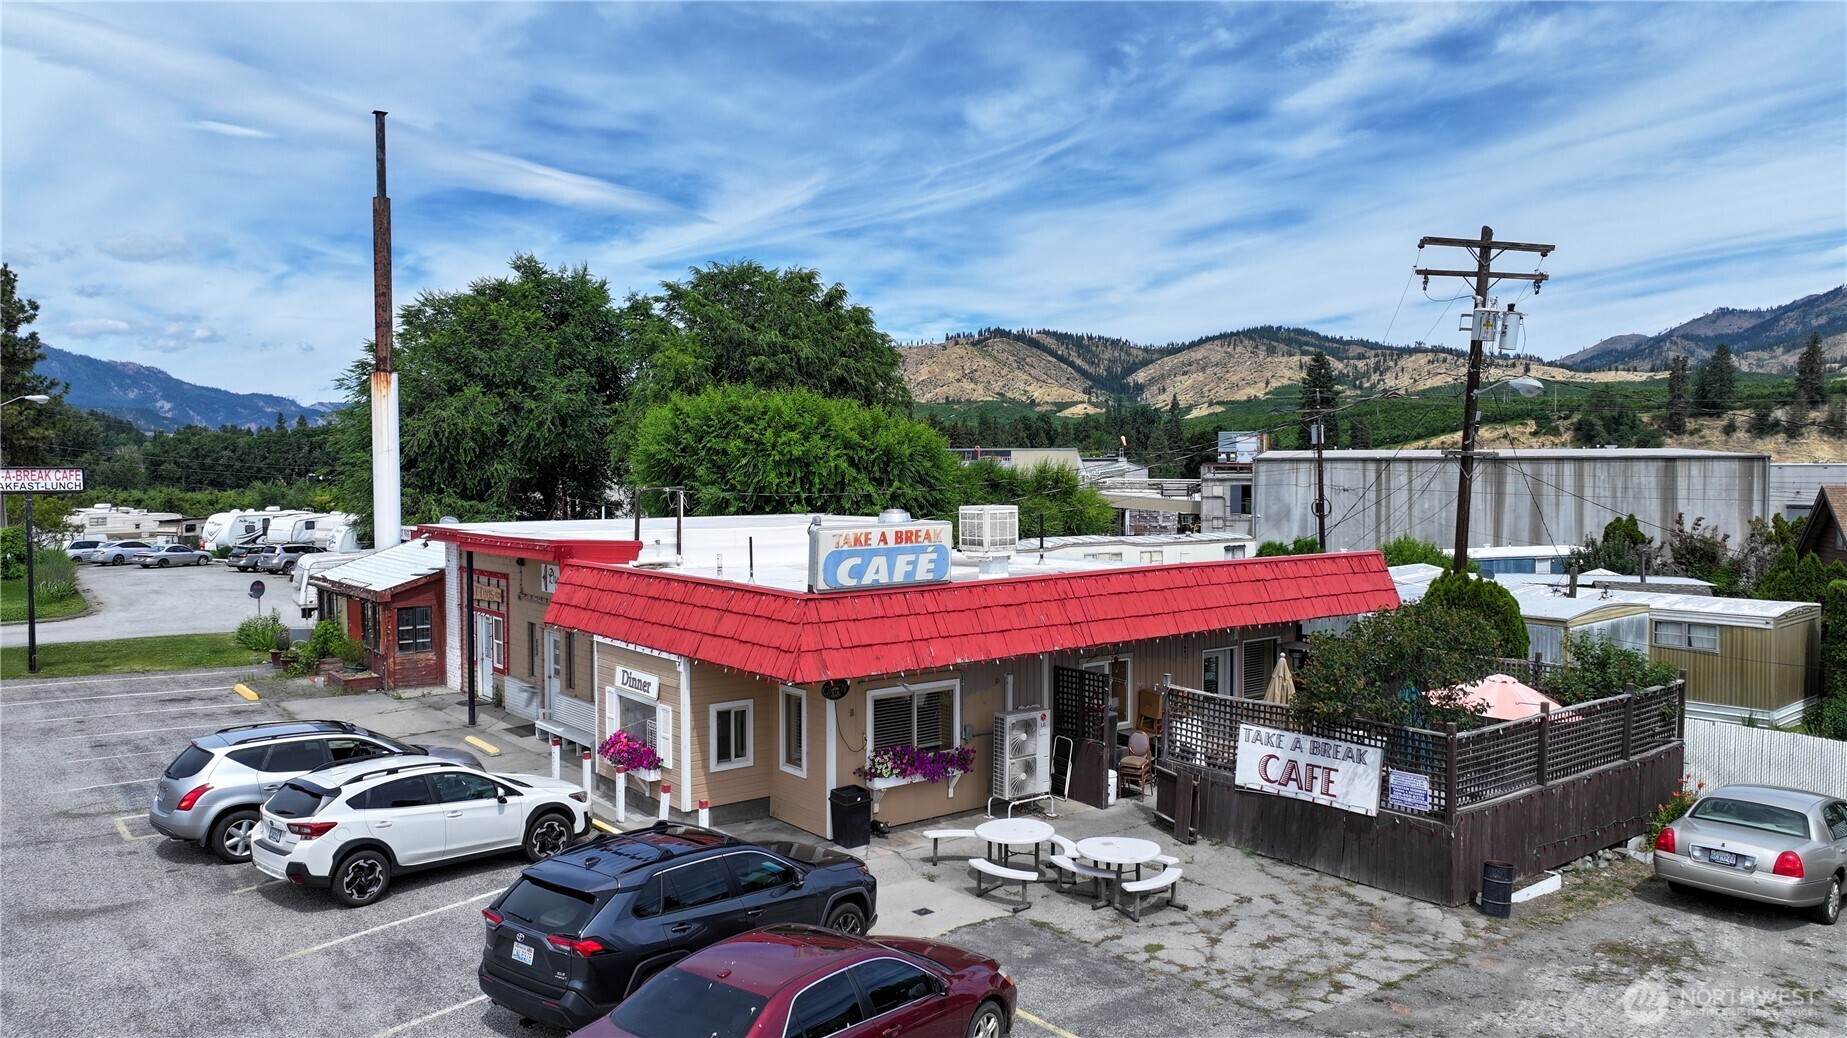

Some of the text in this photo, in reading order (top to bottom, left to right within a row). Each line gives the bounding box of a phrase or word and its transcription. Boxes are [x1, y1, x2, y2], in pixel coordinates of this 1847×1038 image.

[54, 469, 81, 481] CAFE
[832, 528, 943, 548] TAKE A BREAK
[836, 545, 938, 586] CAFÉ
[621, 669, 651, 694] Dinner
[1243, 727, 1368, 765] TAKE A BREAK
[1258, 754, 1339, 798] CAFE
